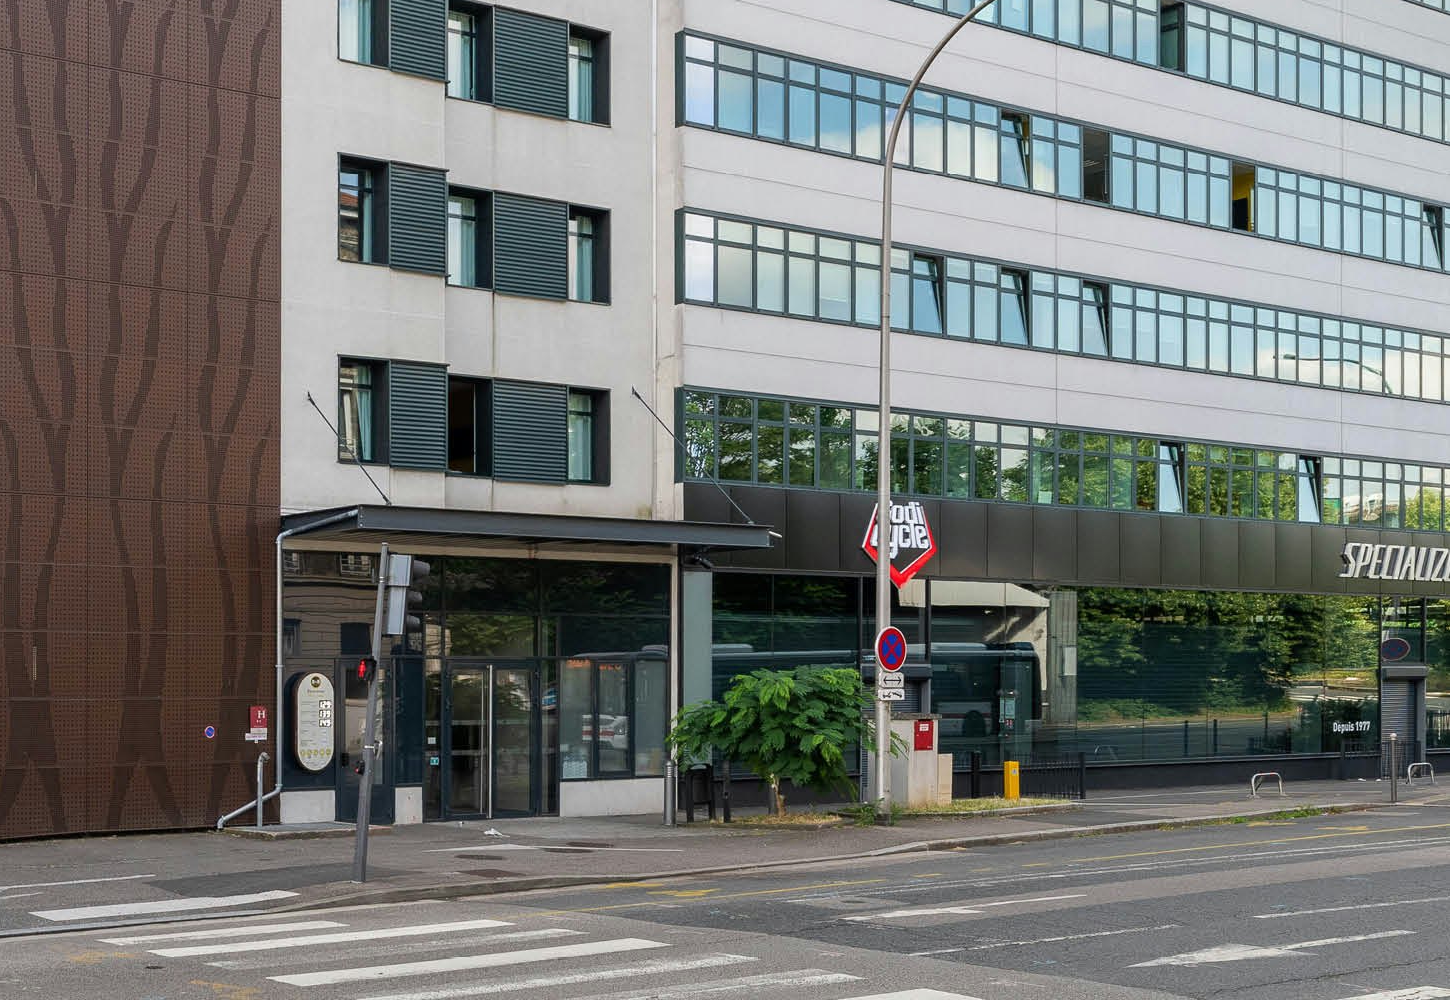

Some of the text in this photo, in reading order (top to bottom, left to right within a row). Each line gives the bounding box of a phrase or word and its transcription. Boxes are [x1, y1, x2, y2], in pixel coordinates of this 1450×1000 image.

[257, 710, 266, 718] H
[1333, 721, 1370, 734] Depuis 1977
